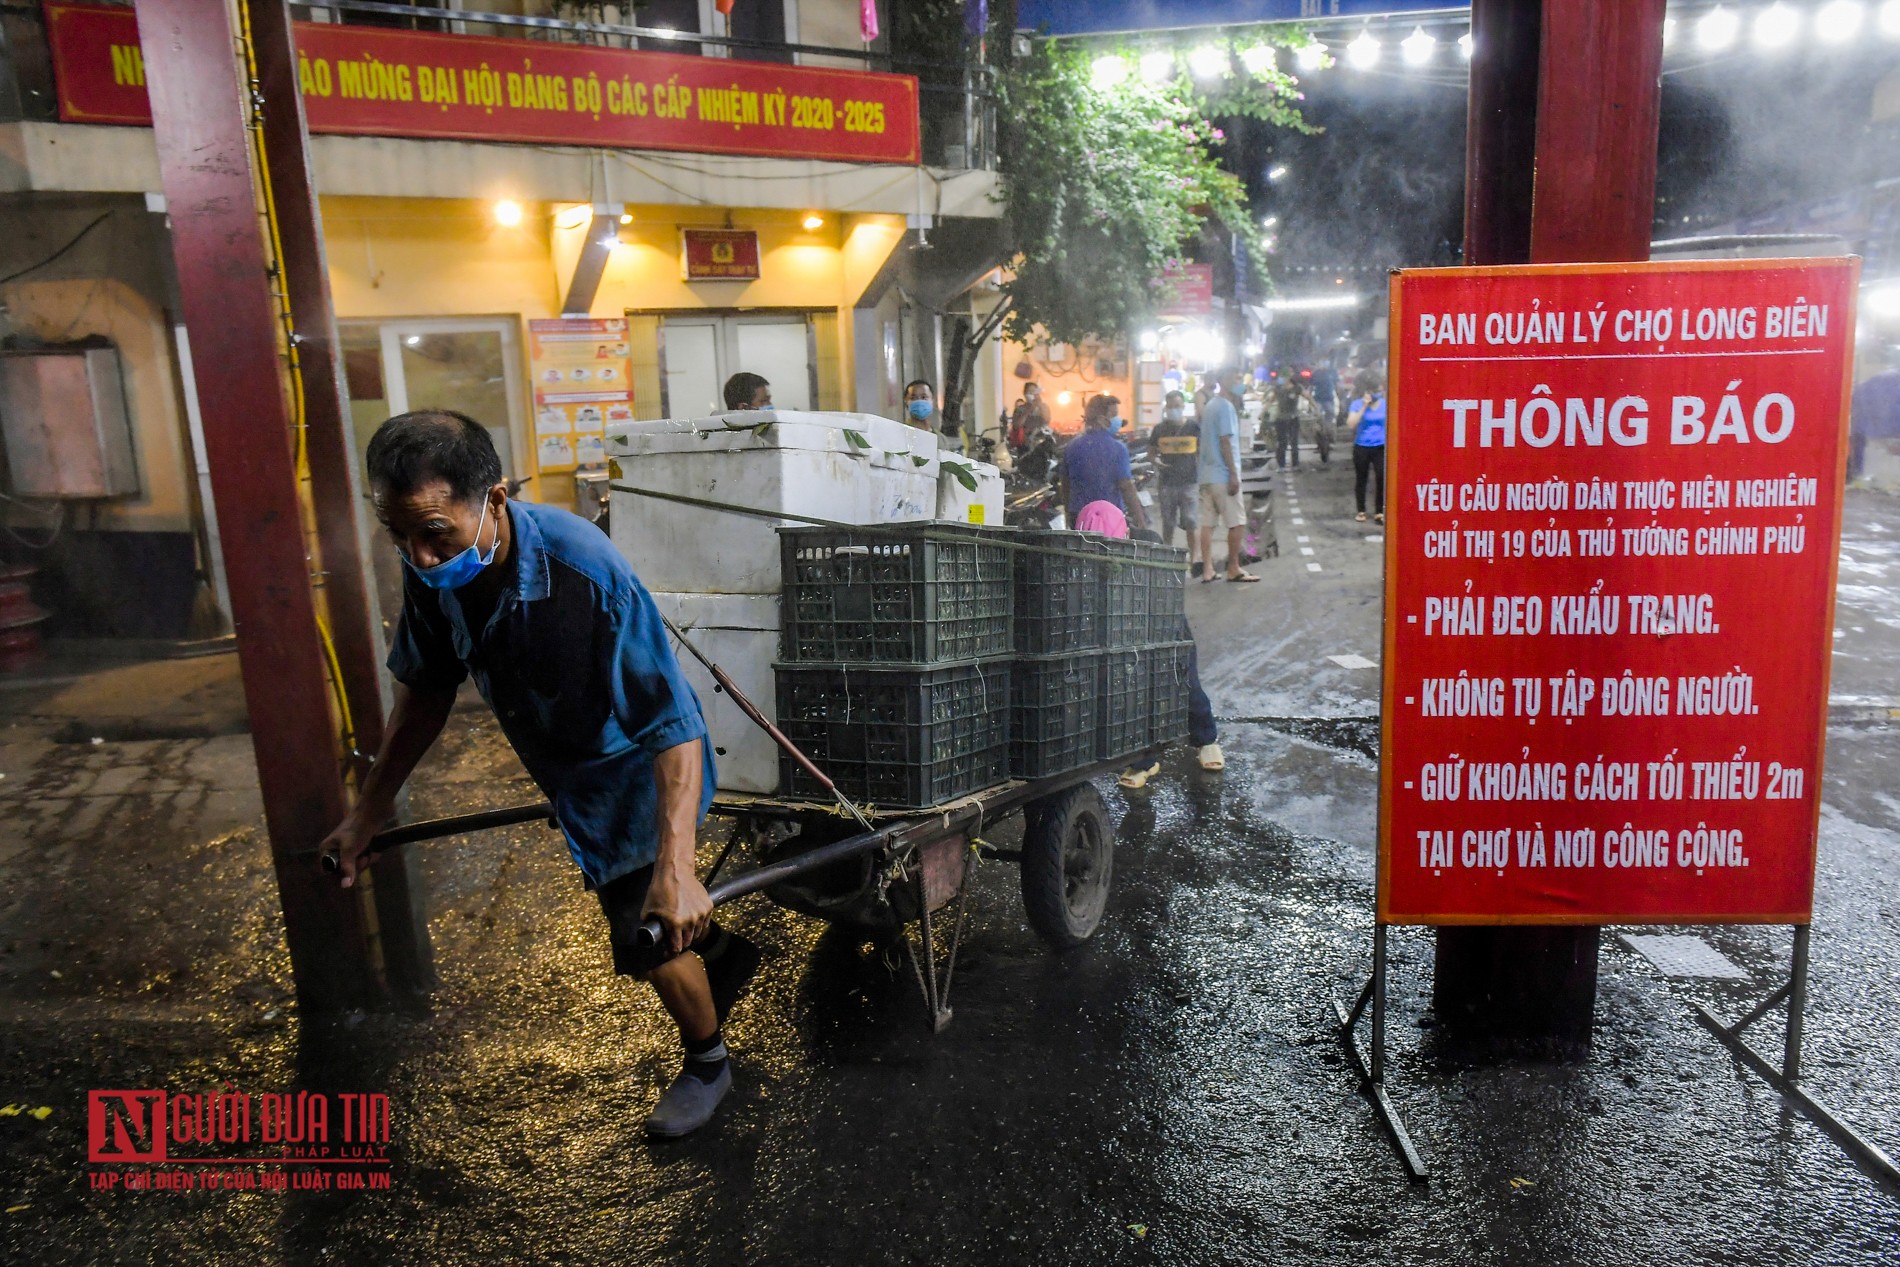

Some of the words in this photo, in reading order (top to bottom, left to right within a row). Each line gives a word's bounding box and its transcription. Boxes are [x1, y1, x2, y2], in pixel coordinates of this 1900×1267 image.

[299, 49, 333, 97] ÀO
[337, 52, 413, 101] MỪNG
[417, 65, 458, 112] ĐẠI
[463, 62, 503, 114] HỘI
[507, 58, 568, 111] ĐẢNG
[572, 70, 602, 121] BỘ
[607, 73, 648, 117] CÁC
[653, 73, 692, 119] CẤP
[697, 83, 759, 131] NHIỆM
[763, 86, 786, 126] KỲ
[1420, 313, 1476, 344] BAN
[1485, 298, 1564, 344] QUẢN
[1573, 302, 1607, 342] LÝ
[1615, 307, 1672, 352] CHỢ
[1681, 307, 1757, 340] LONG
[1765, 296, 1828, 338] BIÊN
[1443, 384, 1648, 448] THÔNG
[1671, 379, 1795, 444] BÁO
[1416, 478, 1453, 511] YÊU
[1460, 474, 1500, 511] CẦU
[1506, 476, 1568, 511] NGƯỜI
[1575, 476, 1617, 510] DÂN
[1623, 479, 1675, 515] THỰC
[1682, 475, 1730, 514] HIỆN
[1736, 472, 1817, 507] NGHIÊM
[1424, 520, 1458, 558] CHỈ
[1464, 531, 1494, 563] THỊ
[1502, 530, 1525, 557] 19
[1531, 518, 1571, 557] CỦA
[1578, 517, 1616, 556] THỦ
[1622, 520, 1688, 556] TƯỚNG
[1695, 522, 1758, 555] CHÍNH
[1763, 514, 1805, 554] PHỦ
[1425, 579, 1484, 635] PHẢI
[1492, 596, 1542, 635] ĐEO
[1551, 579, 1620, 635] KHẨU
[1628, 594, 1720, 636] TRANG.
[1422, 670, 1504, 716] KHÔNG
[1513, 678, 1541, 725] TỤ
[1549, 669, 1595, 724] TẬP
[1602, 669, 1669, 716] ĐÔNG
[1677, 666, 1758, 715] NGƯỜI.
[1421, 754, 1465, 801] GIỮ
[1469, 746, 1566, 800] KHOẢNG
[1574, 755, 1639, 800] CÁCH
[1647, 749, 1684, 800] TỐI
[1692, 746, 1760, 800] THIỂU
[1766, 762, 1804, 799] 2m
[1417, 831, 1453, 876] TẠI
[1462, 828, 1511, 876] CHỢ
[1517, 822, 1546, 867] VÀ
[1554, 828, 1595, 867] NƠI
[1604, 822, 1669, 868] CÔNG
[1677, 822, 1749, 875] CỘNG.
